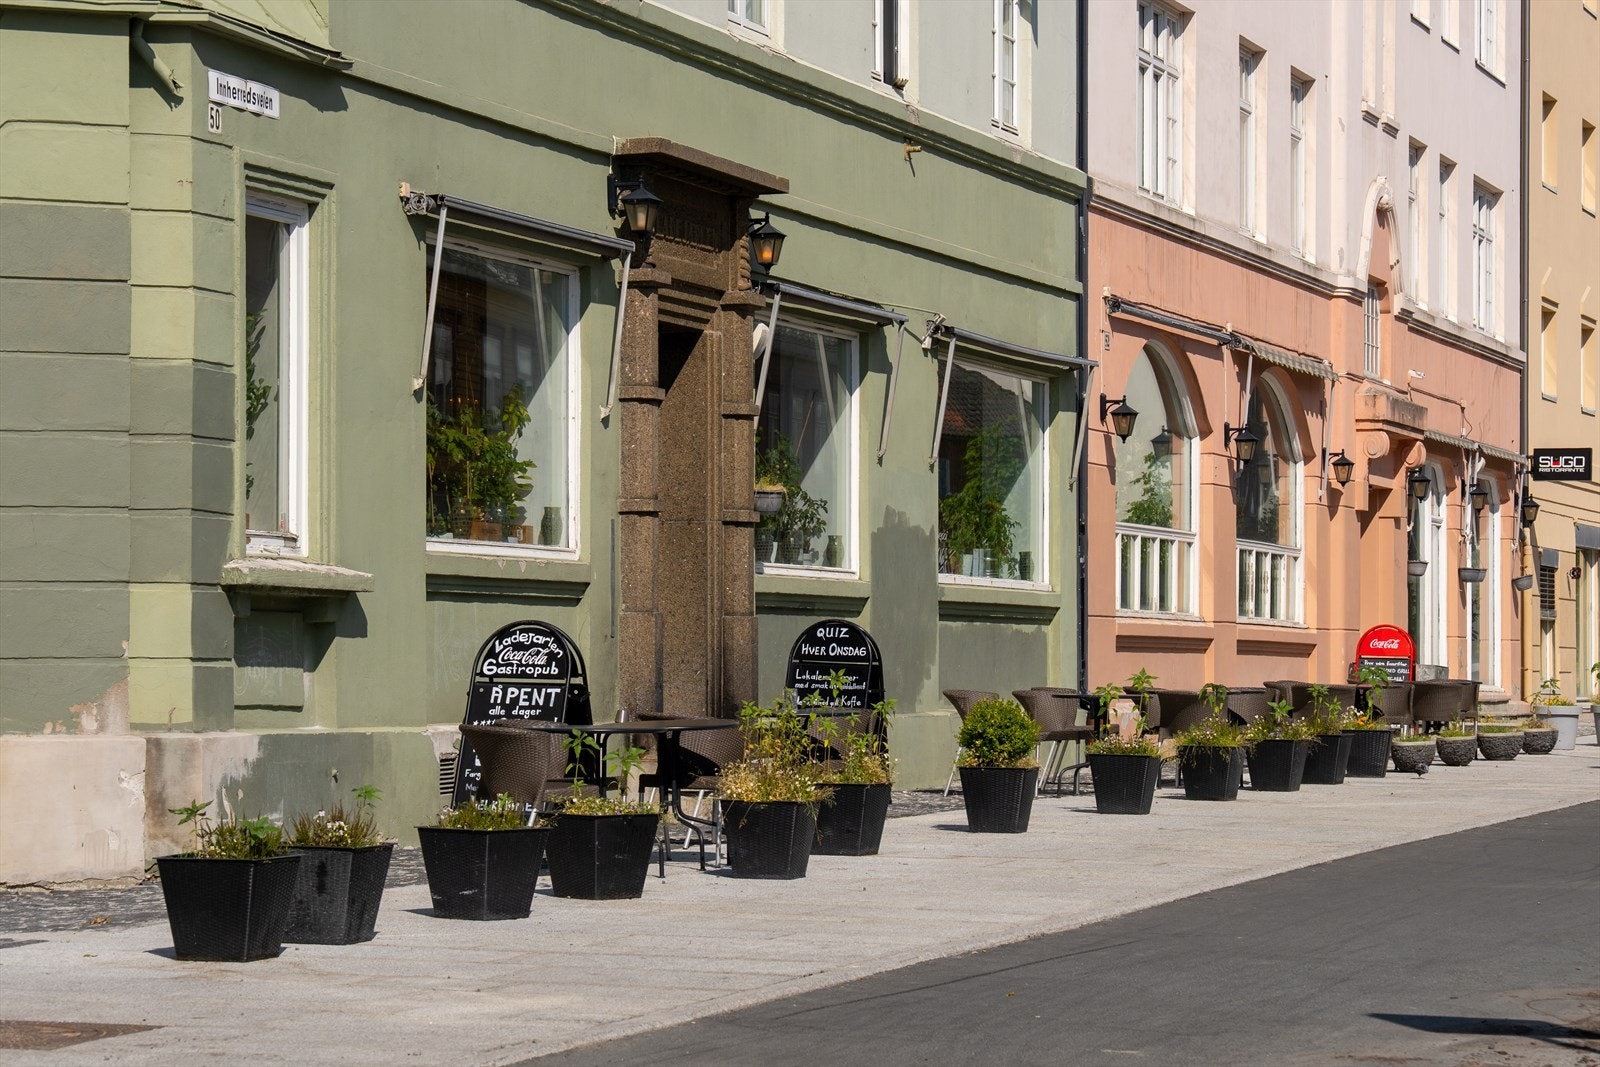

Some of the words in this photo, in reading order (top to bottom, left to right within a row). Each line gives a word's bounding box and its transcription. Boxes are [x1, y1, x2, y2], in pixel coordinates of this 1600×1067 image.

[216, 77, 273, 111] Innherredsveien
[209, 106, 220, 130] 50
[1539, 456, 1585, 467] SUGO
[816, 627, 850, 641] QUIZ
[801, 643, 827, 656] HVER
[828, 642, 867, 657] ONSDAG
[1369, 638, 1400, 649] Coca-Cola
[498, 646, 552, 665] Coca-Cola
[482, 658, 559, 677] Gastropub
[794, 681, 809, 689] med
[810, 681, 829, 690] smak
[490, 684, 561, 707] ÅPENT
[488, 705, 506, 716] alle
[511, 705, 542, 719] dager
